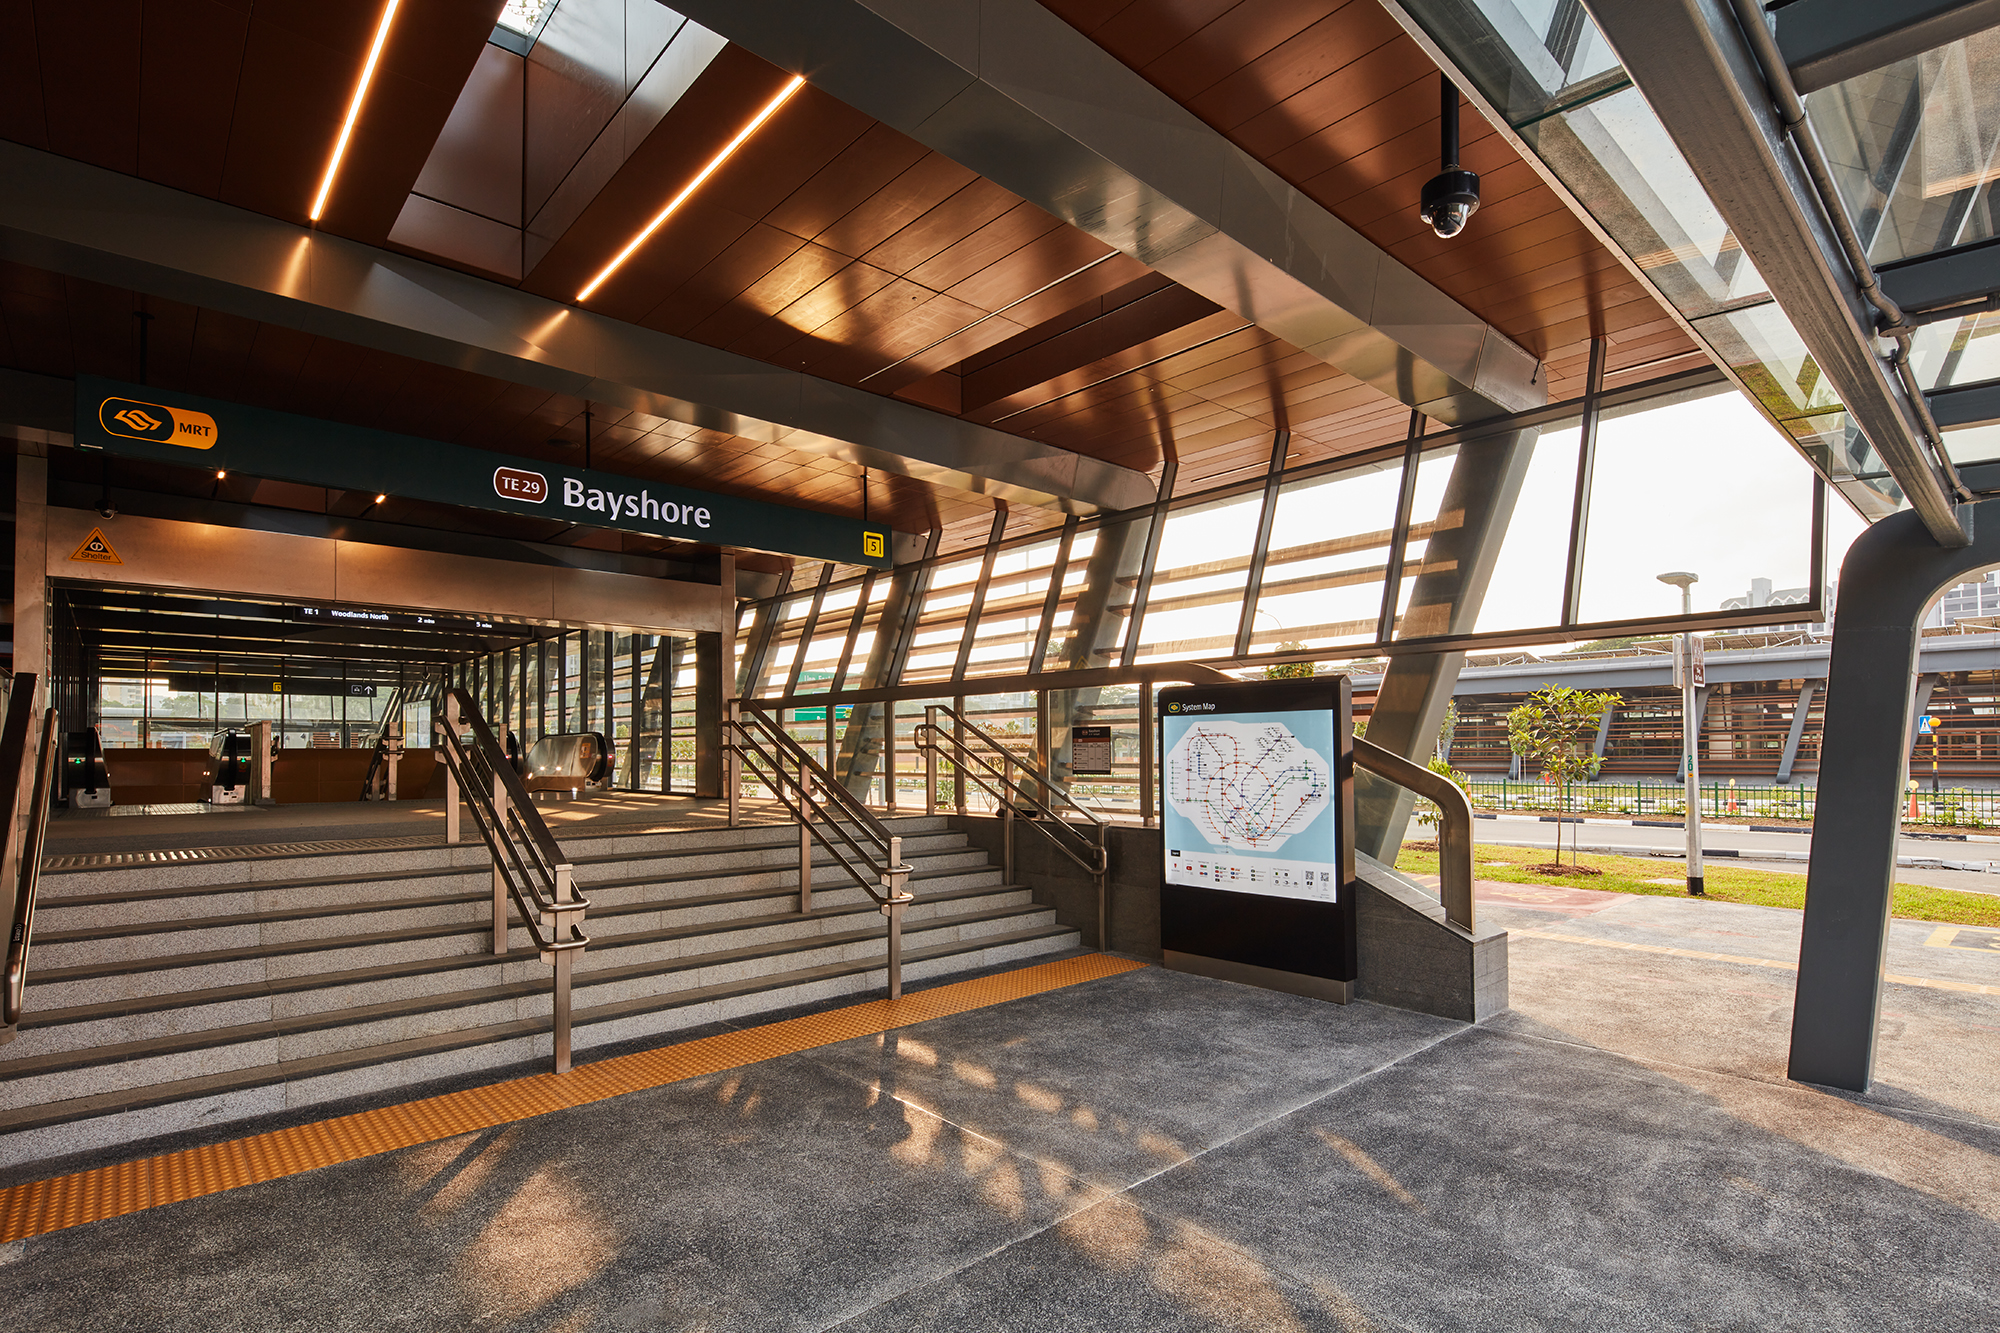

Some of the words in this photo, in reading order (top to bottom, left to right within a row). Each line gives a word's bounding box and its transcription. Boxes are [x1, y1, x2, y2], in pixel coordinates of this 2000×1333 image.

[179, 422, 211, 437] MRT
[502, 475, 520, 492] TE
[521, 478, 541, 495] 29
[563, 476, 711, 529] Bayshore
[871, 541, 877, 552] 5
[81, 551, 112, 561] Shelter
[303, 607, 313, 615] TE
[314, 608, 319, 616] 1
[331, 610, 369, 619] Woodlands
[369, 612, 389, 621] North
[1182, 703, 1202, 713] System
[1202, 702, 1216, 712] Map
[1687, 754, 1694, 771] 20
